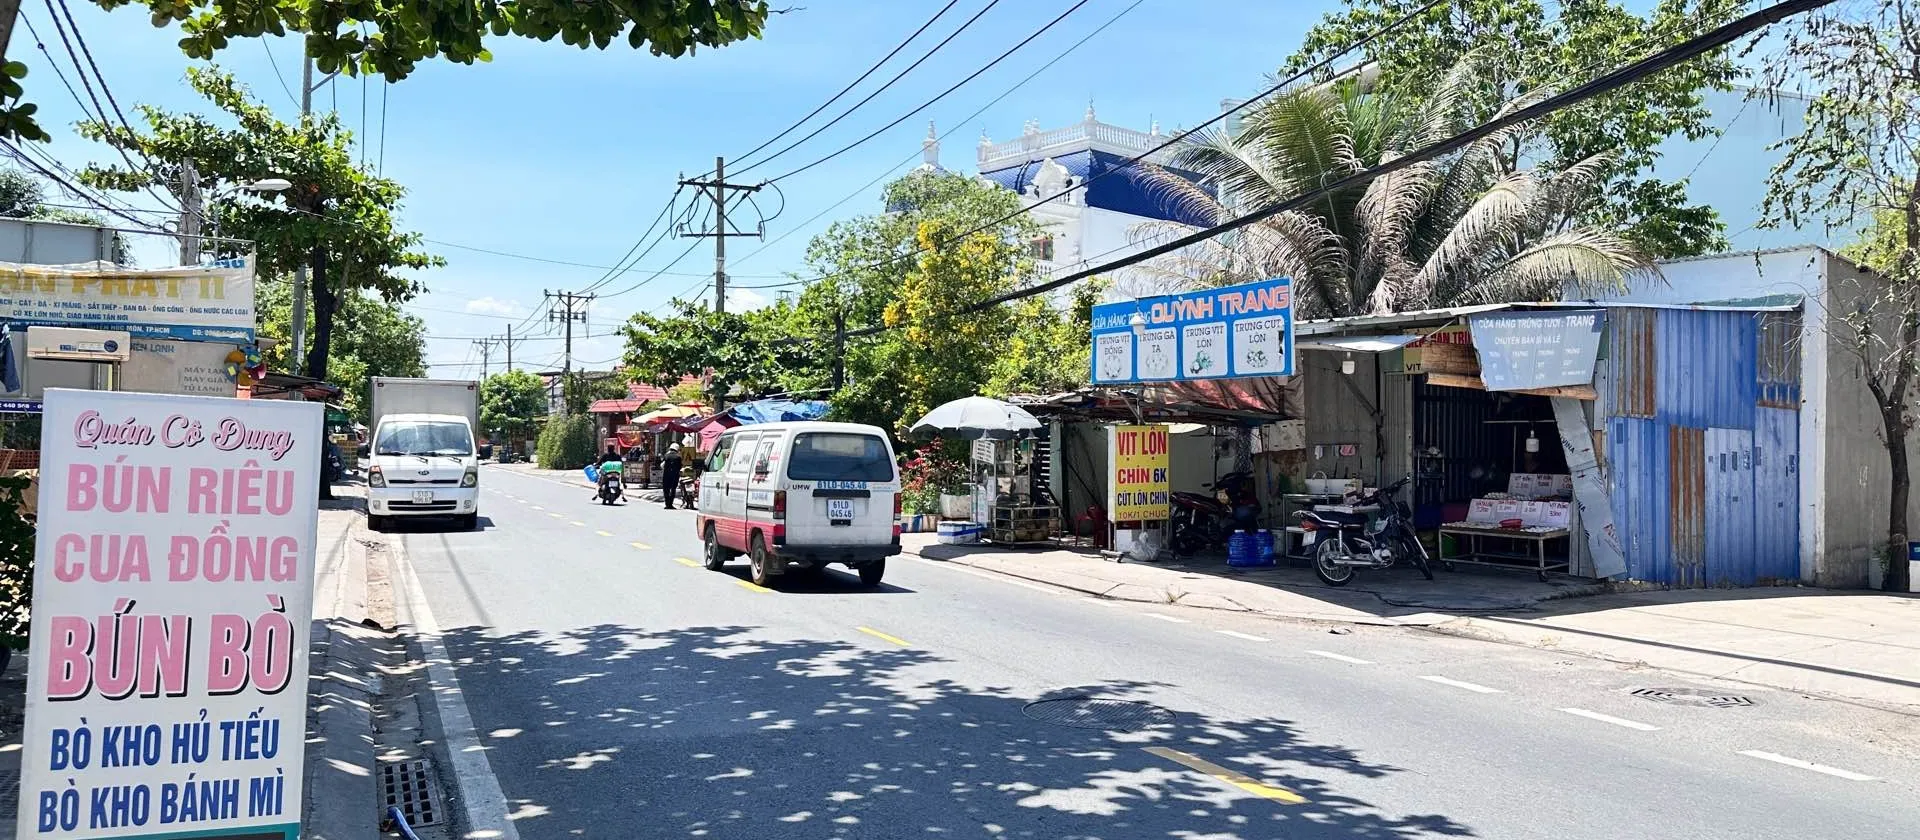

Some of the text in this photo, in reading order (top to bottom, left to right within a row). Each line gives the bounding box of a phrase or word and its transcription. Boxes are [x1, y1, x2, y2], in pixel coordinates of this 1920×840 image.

[1151, 295, 1213, 324] QUỲNH
[1218, 284, 1289, 316] TRANG
[1495, 316, 1516, 329] HÀNG
[1565, 314, 1596, 328] TRANG
[74, 409, 155, 449] Quán
[161, 414, 205, 448] Cô
[1117, 426, 1167, 461] VỊT LỘN
[67, 455, 295, 516] BÚN RIÊU
[1117, 464, 1167, 484] CHÍN 6K
[832, 500, 849, 509] 61LD
[1117, 489, 1131, 506] CÚT
[1133, 488, 1148, 509] LỘN
[54, 519, 298, 583] CUA ĐỒNG
[47, 594, 296, 702] BÚN BÒ
[50, 706, 280, 771] BÒ KHO HỦ TIẾU
[38, 767, 285, 833] BÒ KHO BÁNH MÌ
